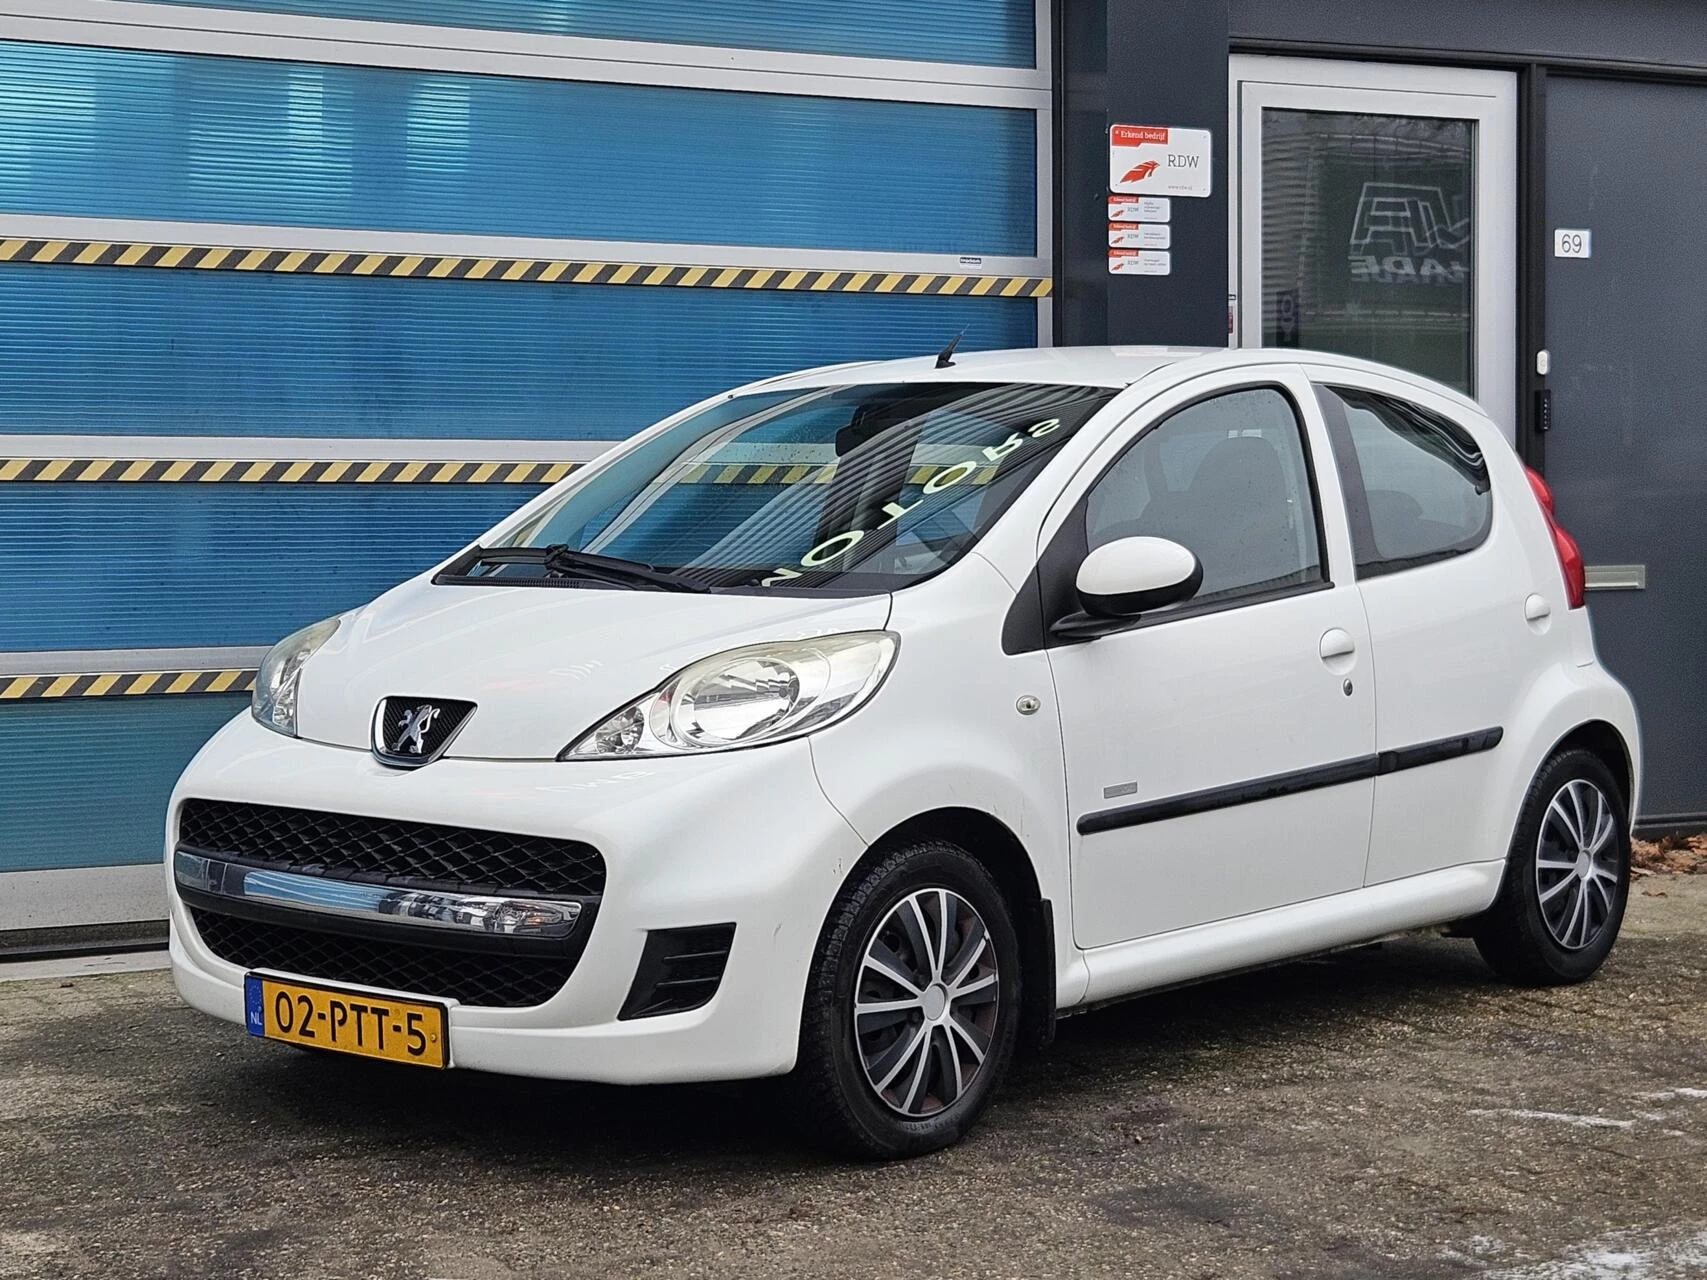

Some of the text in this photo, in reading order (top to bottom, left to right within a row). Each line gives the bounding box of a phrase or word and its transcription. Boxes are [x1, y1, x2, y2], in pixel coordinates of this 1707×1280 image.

[1120, 130, 1165, 141] Erkend bedrijf
[1167, 154, 1200, 169] RDW
[1561, 233, 1582, 253] 69
[250, 1011, 263, 1026] NL
[275, 991, 427, 1057] 02-PTT-5
